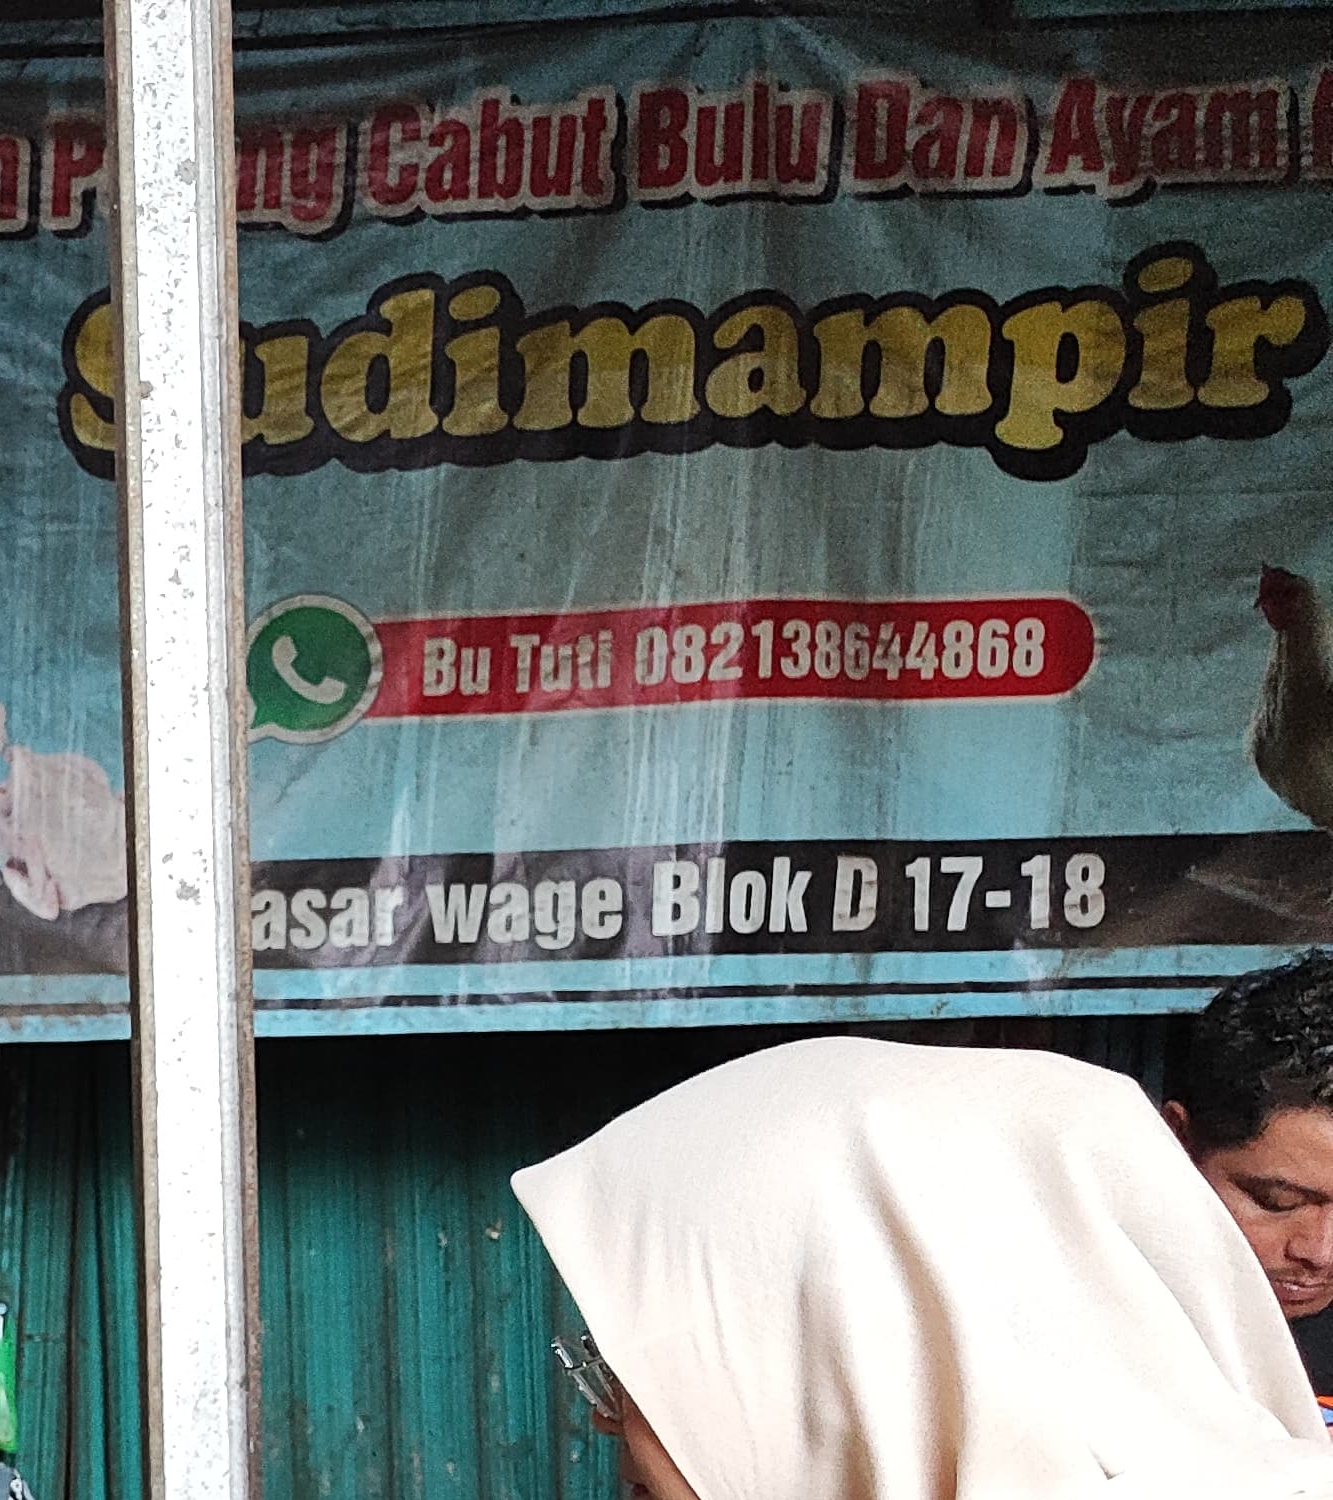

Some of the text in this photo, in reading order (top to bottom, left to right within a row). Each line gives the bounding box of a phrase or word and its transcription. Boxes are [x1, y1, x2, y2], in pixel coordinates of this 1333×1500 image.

[50, 120, 339, 223] Png
[367, 98, 606, 204] Cabut
[636, 79, 824, 190] Bulu
[851, 77, 1021, 183] Dan
[1043, 75, 1283, 192] Ayam
[422, 616, 1046, 698] Bu Tuti 082138644868
[252, 851, 1105, 952] asar wage Blok D 17-18
